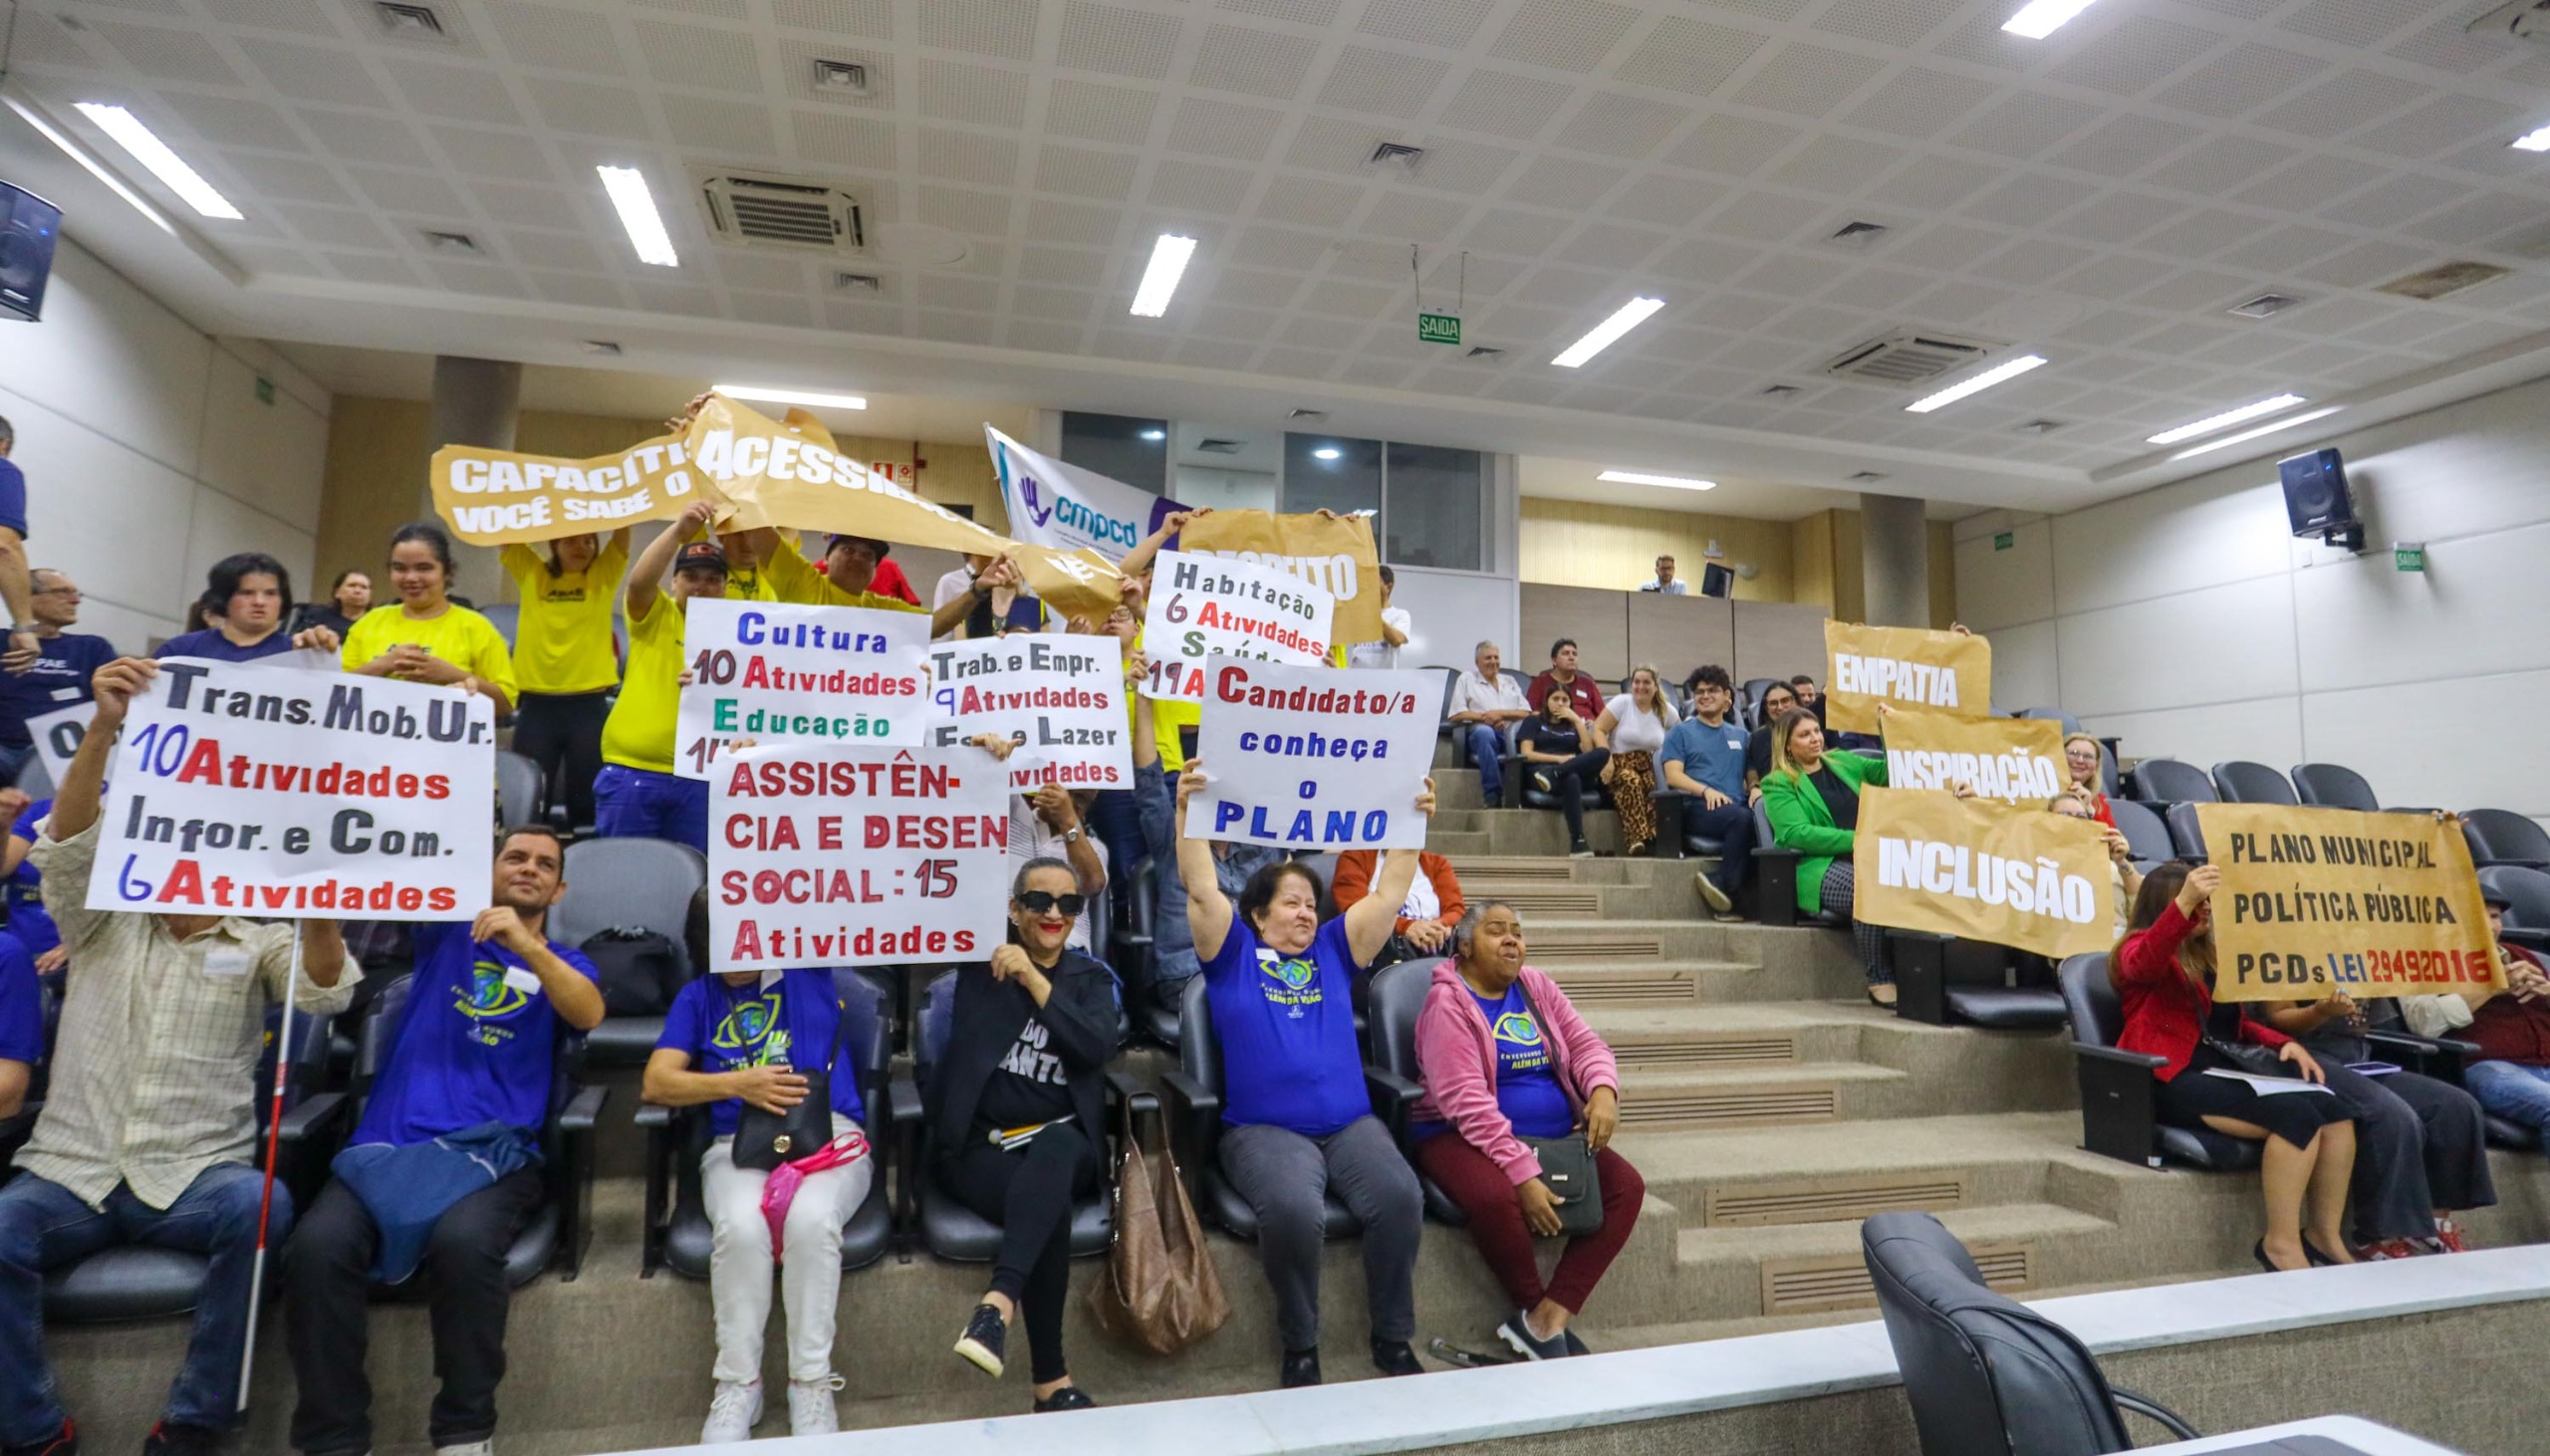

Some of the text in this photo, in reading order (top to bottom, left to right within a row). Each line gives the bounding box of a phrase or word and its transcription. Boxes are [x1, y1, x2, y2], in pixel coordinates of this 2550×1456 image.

[1420, 316, 1459, 337] SAÍDA
[452, 470, 692, 534] VOCÊ SABE O
[1054, 496, 1138, 549] cmpcd
[1173, 562, 1315, 620] Habitação
[737, 611, 888, 654] Cultura
[1165, 593, 1325, 657] 6 Atividades
[692, 649, 916, 697] 10 Atividades
[931, 642, 1101, 682] Trab. e Empr.
[1835, 652, 1959, 708] EMPATIA
[935, 685, 1109, 717] 9 Atividades
[1216, 665, 1416, 714] Candidato/a
[713, 698, 891, 739] Educação
[1037, 716, 1118, 747] Lazer
[1239, 732, 1389, 762] conheça
[727, 748, 961, 799] ASSISTÊN-
[1887, 747, 2061, 807] INSPIRAÇÃO
[125, 796, 454, 857] Infor. e Com.
[724, 813, 801, 851] CIA
[818, 816, 844, 850] E
[1214, 800, 1389, 843] PLANO
[2229, 833, 2437, 868] PLANO MUNICIPAL
[913, 858, 958, 899] 15
[1878, 837, 2096, 924] INCLUSÃO
[2233, 882, 2457, 924] POLÍTICA PÚBLICA
[730, 919, 976, 961] Atividades
[2237, 951, 2326, 984] PCDs
[2327, 953, 2368, 983] LEI
